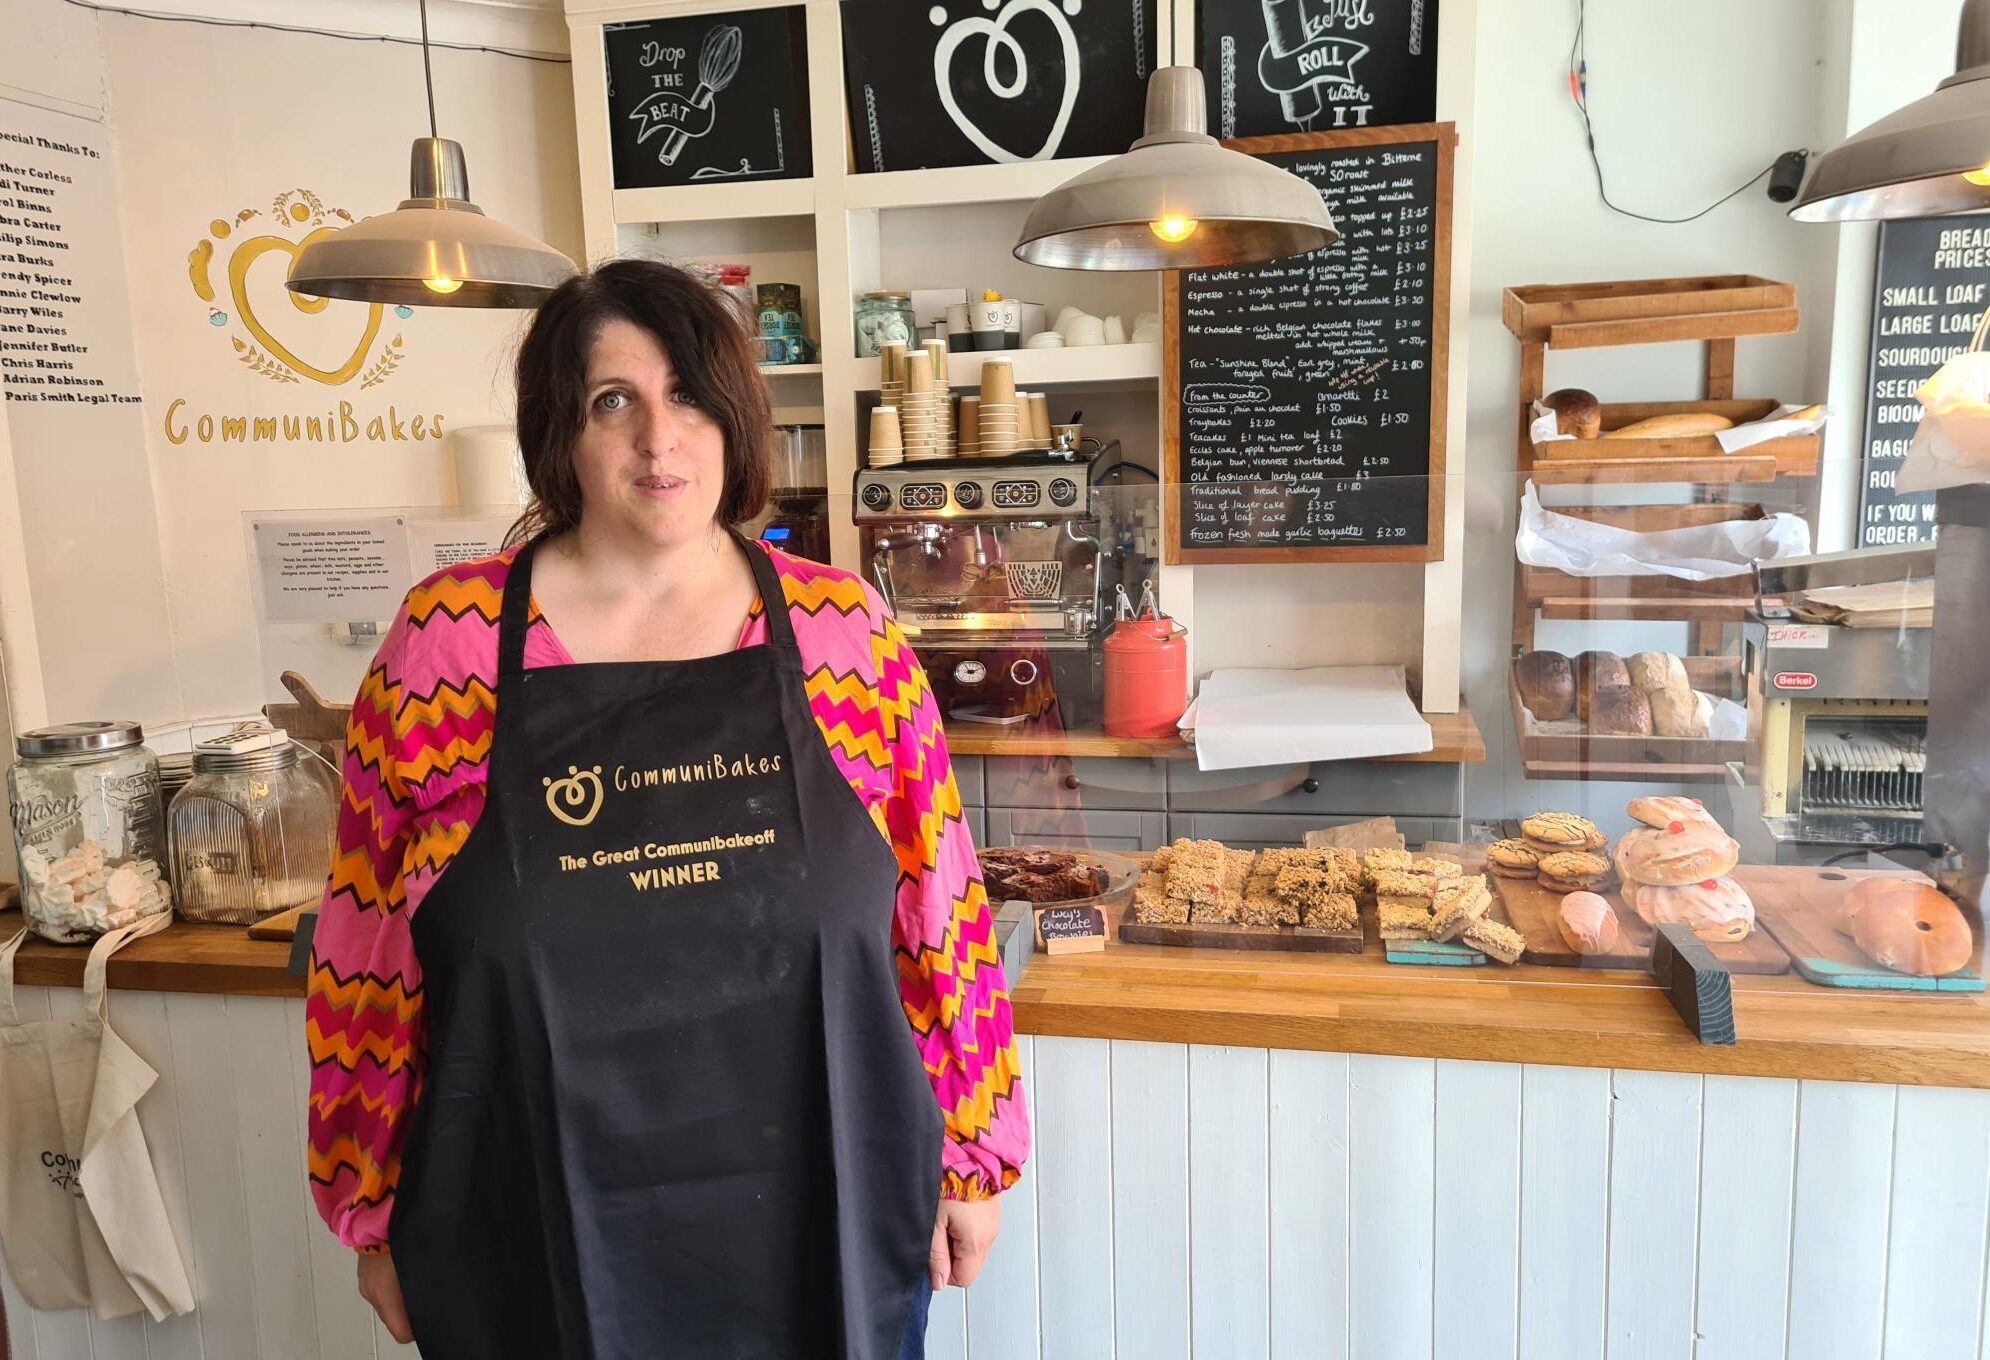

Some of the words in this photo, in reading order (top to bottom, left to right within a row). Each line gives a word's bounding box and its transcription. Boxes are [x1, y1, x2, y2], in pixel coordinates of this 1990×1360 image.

[640, 41, 685, 69] Drop
[1298, 46, 1344, 75] ROLL
[652, 74, 684, 87] THE
[1328, 84, 1370, 101] with
[650, 103, 690, 121] BEAT
[1333, 106, 1373, 126] IT
[36, 137, 79, 155] Thanks
[81, 147, 100, 159] To:
[29, 168, 72, 183] Corless
[13, 181, 55, 196] Turner
[16, 199, 52, 213] Binns
[24, 218, 61, 231] Carter
[25, 236, 69, 249] Simons
[1940, 228, 1990, 249] BREAD
[17, 253, 54, 266] Burks
[34, 273, 72, 286] Spicer
[1189, 273, 1207, 282] Flat
[1212, 270, 1239, 281] white
[31, 290, 81, 303] Clewlow
[1188, 291, 1223, 302] Espresso
[1249, 286, 1274, 299] single
[1883, 286, 1938, 307] SMALL
[1946, 284, 1986, 304] LOAF
[30, 307, 63, 318] Wiles
[1188, 308, 1215, 316] Mocha
[27, 324, 67, 335] Davies
[1188, 325, 1201, 333] Hot
[1881, 316, 1932, 336] LARGE
[51, 343, 87, 353] Butler
[2, 358, 33, 368] Chris
[35, 359, 73, 369] Harris
[1189, 359, 1207, 368] Tea
[4, 374, 44, 384] Adrian
[47, 375, 104, 385] Robinson
[5, 392, 37, 401] Paris
[41, 393, 75, 401] Smith
[77, 393, 109, 404] Legal
[111, 394, 142, 403] Team
[1229, 390, 1265, 399] counter
[1374, 389, 1390, 402] £2
[165, 398, 445, 445] CommuniBakes
[1189, 418, 1232, 430] Traybakes
[1332, 414, 1368, 426] Cookies
[1190, 432, 1227, 441] Teacakes
[1241, 432, 1251, 442] £1
[1304, 430, 1320, 444] loaf
[1330, 429, 1342, 439] £2
[1245, 445, 1264, 455] apple
[1270, 444, 1305, 452] turnover
[1191, 457, 1222, 471] Belgian
[1294, 457, 1346, 465] shortbread
[1191, 473, 1209, 481] Old
[1216, 473, 1262, 483] fashioned
[1272, 472, 1296, 486] lardy
[1191, 485, 1242, 495] Traditional
[1254, 486, 1278, 494] bread
[1286, 486, 1320, 499] pudding
[1194, 501, 1214, 510] Slice
[1219, 500, 1229, 511] of
[1234, 500, 1261, 512] layer
[1867, 504, 1884, 522] IF
[1888, 504, 1916, 522] YOU
[1195, 513, 1216, 521] Slice
[1221, 513, 1229, 524] of
[1235, 512, 1255, 526] loaf
[1228, 528, 1251, 541] fresh
[1258, 528, 1280, 537] made
[1286, 526, 1312, 540] garlic
[1318, 525, 1363, 540] baguettes
[1377, 527, 1406, 538] £2.50
[1780, 675, 1811, 685] Berkel
[615, 753, 781, 792] CommuniBakes
[559, 855, 587, 871] The
[592, 846, 640, 867] Great
[630, 860, 721, 892] WINNER
[1052, 909, 1081, 919] Lucy's
[1042, 919, 1092, 930] Chocolate
